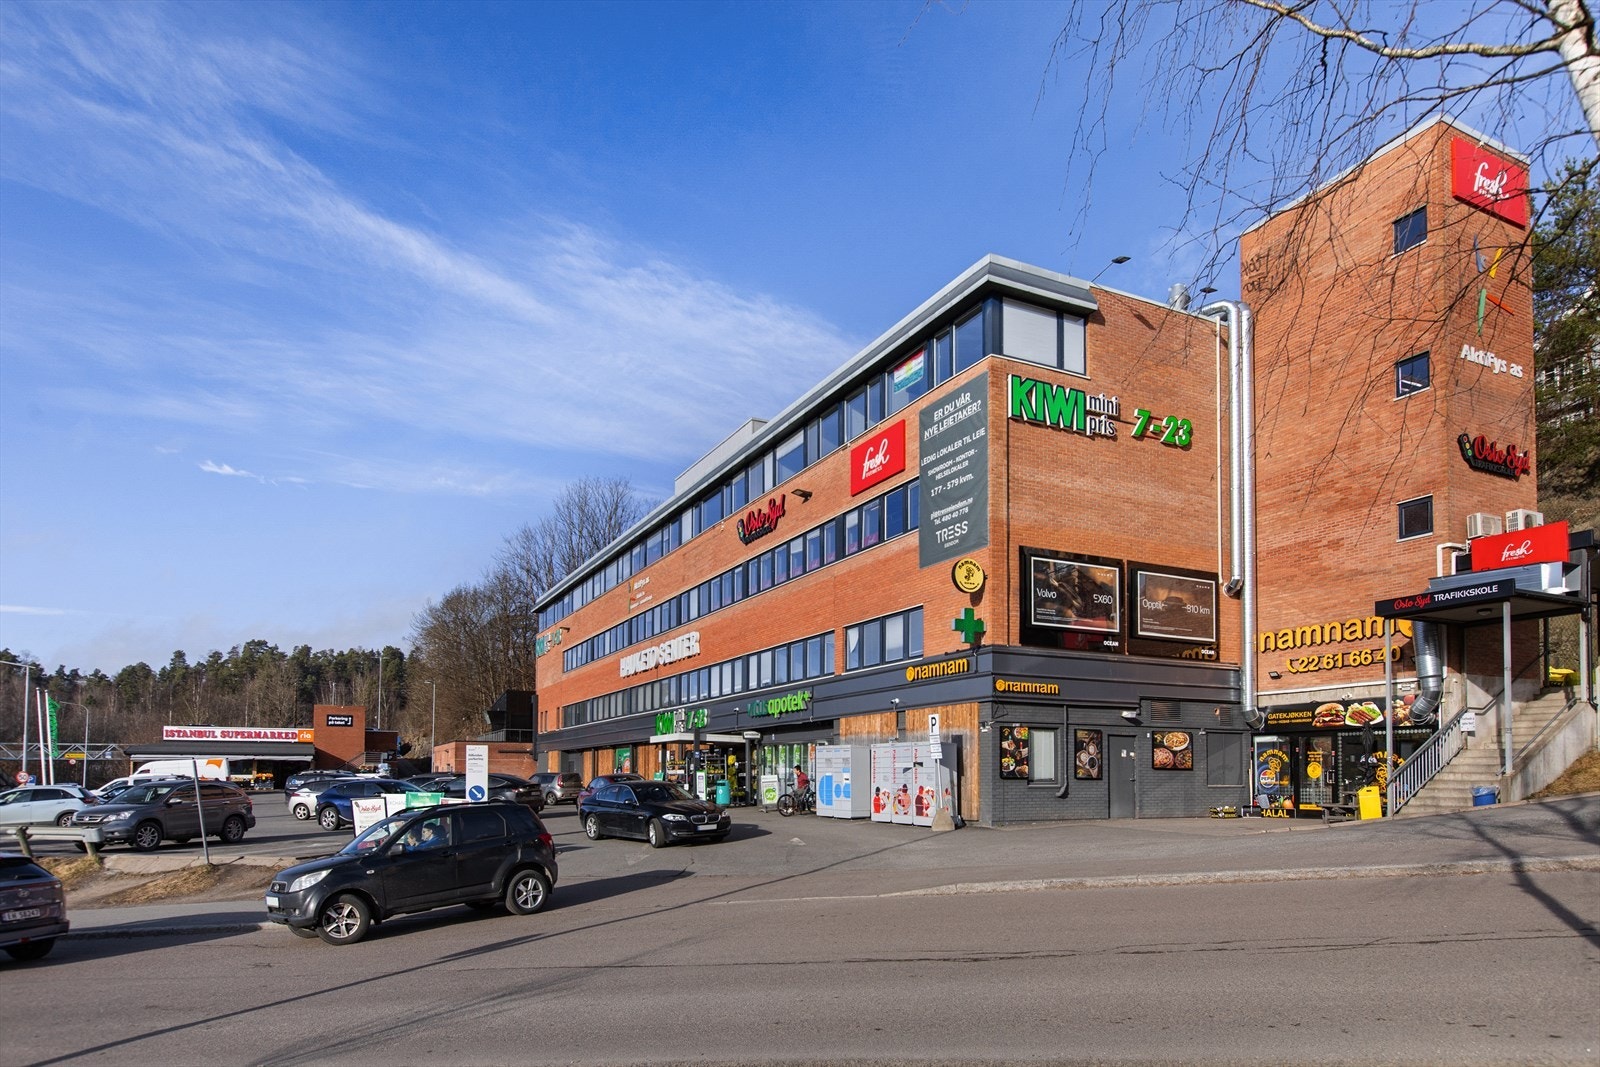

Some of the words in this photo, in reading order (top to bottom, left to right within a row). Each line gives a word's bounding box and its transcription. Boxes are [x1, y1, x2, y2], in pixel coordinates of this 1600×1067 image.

[1474, 162, 1509, 198] fresh
[1510, 363, 1523, 378] as
[934, 409, 943, 421] ER
[944, 402, 954, 415] DU
[956, 392, 971, 408] VÅR
[1008, 374, 1086, 433] KIWI
[1087, 394, 1119, 416] mini
[924, 424, 938, 440] NYE
[940, 400, 981, 431] LEIETAKER?
[1087, 415, 1117, 436] pris
[921, 454, 936, 466] LEDIG
[937, 440, 962, 459] LOKALER
[963, 435, 972, 445] TIL
[972, 427, 986, 440] LEIE
[1473, 435, 1505, 463] Oslo
[1507, 443, 1530, 476] Syd
[862, 438, 890, 479] fresh
[928, 459, 953, 476] SHOWROOM
[956, 449, 975, 463] KONTOR
[935, 460, 969, 480] HELSELOKALER
[930, 485, 943, 496] 177
[947, 478, 959, 491] 579
[959, 473, 974, 485] kvm.
[936, 521, 968, 543] TRESS
[1501, 540, 1533, 561] fresh
[958, 561, 980, 572] namnam
[1036, 588, 1057, 599] Volvo
[1394, 597, 1413, 610] Oslo
[1415, 594, 1431, 608] Syd
[1434, 584, 1498, 602] TRAFIKKSKOLE
[1199, 606, 1210, 614] km
[659, 631, 700, 664] SENTER
[914, 658, 968, 679] namnam
[1299, 656, 1320, 673] 22
[1323, 652, 1344, 669] 61
[1349, 649, 1373, 667] 66
[1377, 645, 1401, 662] 40
[1004, 681, 1059, 695] namnam
[931, 717, 936, 733] P
[1268, 711, 1312, 720] GATEKJØKKEN
[165, 729, 217, 738] ISTANBUL
[220, 730, 297, 740] SUPERMARKED
[1259, 749, 1289, 762] namnam
[1261, 809, 1289, 818] HALAL
